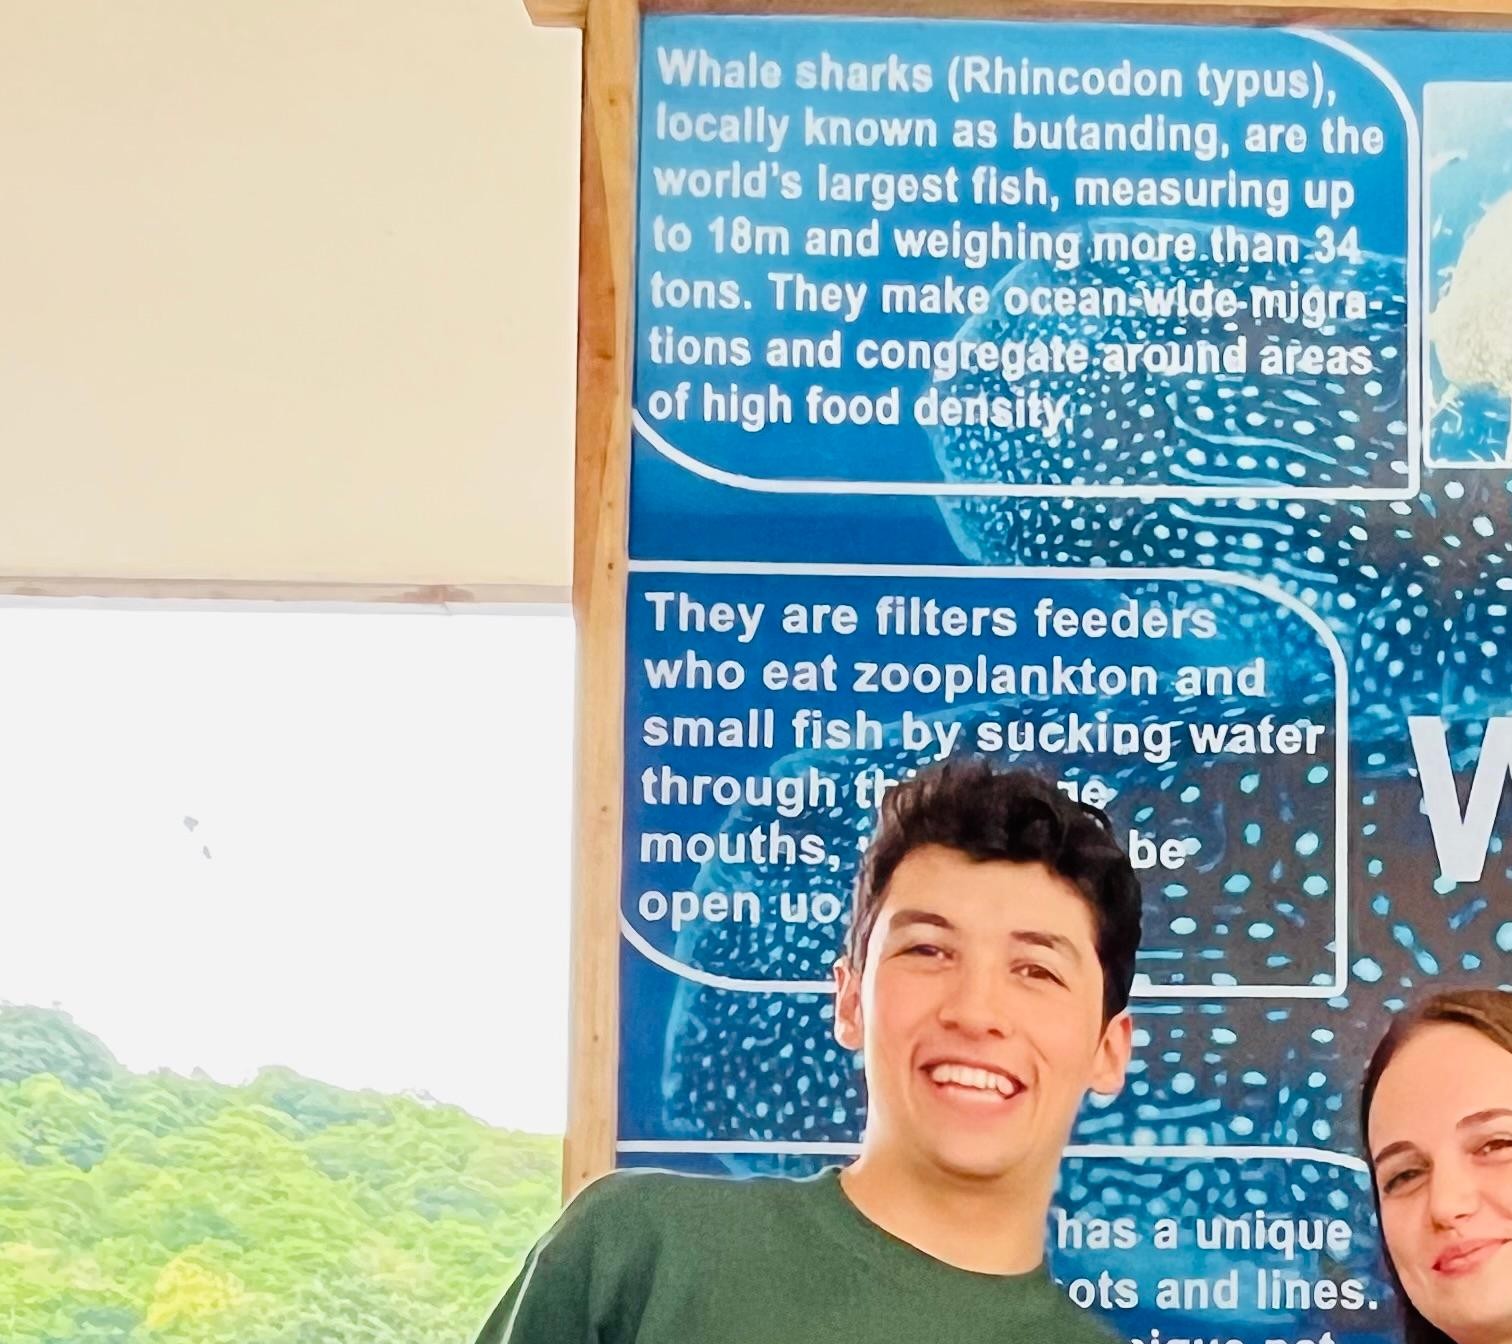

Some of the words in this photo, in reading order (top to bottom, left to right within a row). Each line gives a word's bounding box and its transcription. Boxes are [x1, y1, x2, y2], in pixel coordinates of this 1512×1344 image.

[658, 46, 781, 89] Whale
[796, 51, 933, 92] sharks
[948, 56, 1183, 102] (Rhincodon
[1199, 61, 1336, 108] typus),
[656, 101, 789, 152] locally
[805, 107, 937, 147] known
[953, 118, 997, 149] as
[1012, 112, 1229, 161] butanding,
[1245, 123, 1307, 153] are
[1322, 116, 1384, 155] the
[818, 163, 959, 212] largest
[972, 166, 1059, 212] fish,
[1075, 168, 1289, 218] measuring
[1304, 179, 1355, 220] up
[653, 215, 692, 253] to
[708, 216, 789, 255] 18m
[805, 218, 879, 257] and
[894, 221, 1080, 270] weighing
[1093, 230, 1196, 263] more
[1211, 225, 1299, 264] than
[1314, 225, 1361, 264] 34
[651, 271, 751, 310] tons.
[767, 272, 868, 322] They
[882, 276, 989, 314] make
[649, 326, 751, 366] tions
[767, 330, 841, 369] and
[857, 338, 1088, 382] congregate
[1102, 336, 1247, 376] around
[1260, 342, 1373, 375] areas
[649, 381, 691, 421] of
[703, 383, 792, 432] high
[806, 386, 899, 425] food
[644, 592, 765, 643] They
[782, 603, 858, 636] are
[876, 595, 1017, 636] filters
[1034, 598, 1217, 639] feeders
[644, 649, 745, 690] who
[762, 654, 837, 692] eat
[853, 654, 1157, 703] zooplankton
[1174, 658, 1265, 697] and
[643, 708, 774, 748] small
[792, 709, 883, 751] fish
[903, 711, 961, 761] by
[977, 713, 1175, 763] sucking
[1189, 715, 1325, 755] water
[641, 766, 836, 818] through
[640, 820, 841, 872] mouths,
[1129, 829, 1187, 869] be
[639, 890, 760, 931] open
[1057, 1208, 1137, 1250] has
[1154, 1218, 1177, 1249] a
[1197, 1210, 1352, 1260] unique
[1055, 1270, 1138, 1309] ots
[1156, 1269, 1238, 1310] and
[1257, 1269, 1377, 1310] lines.
